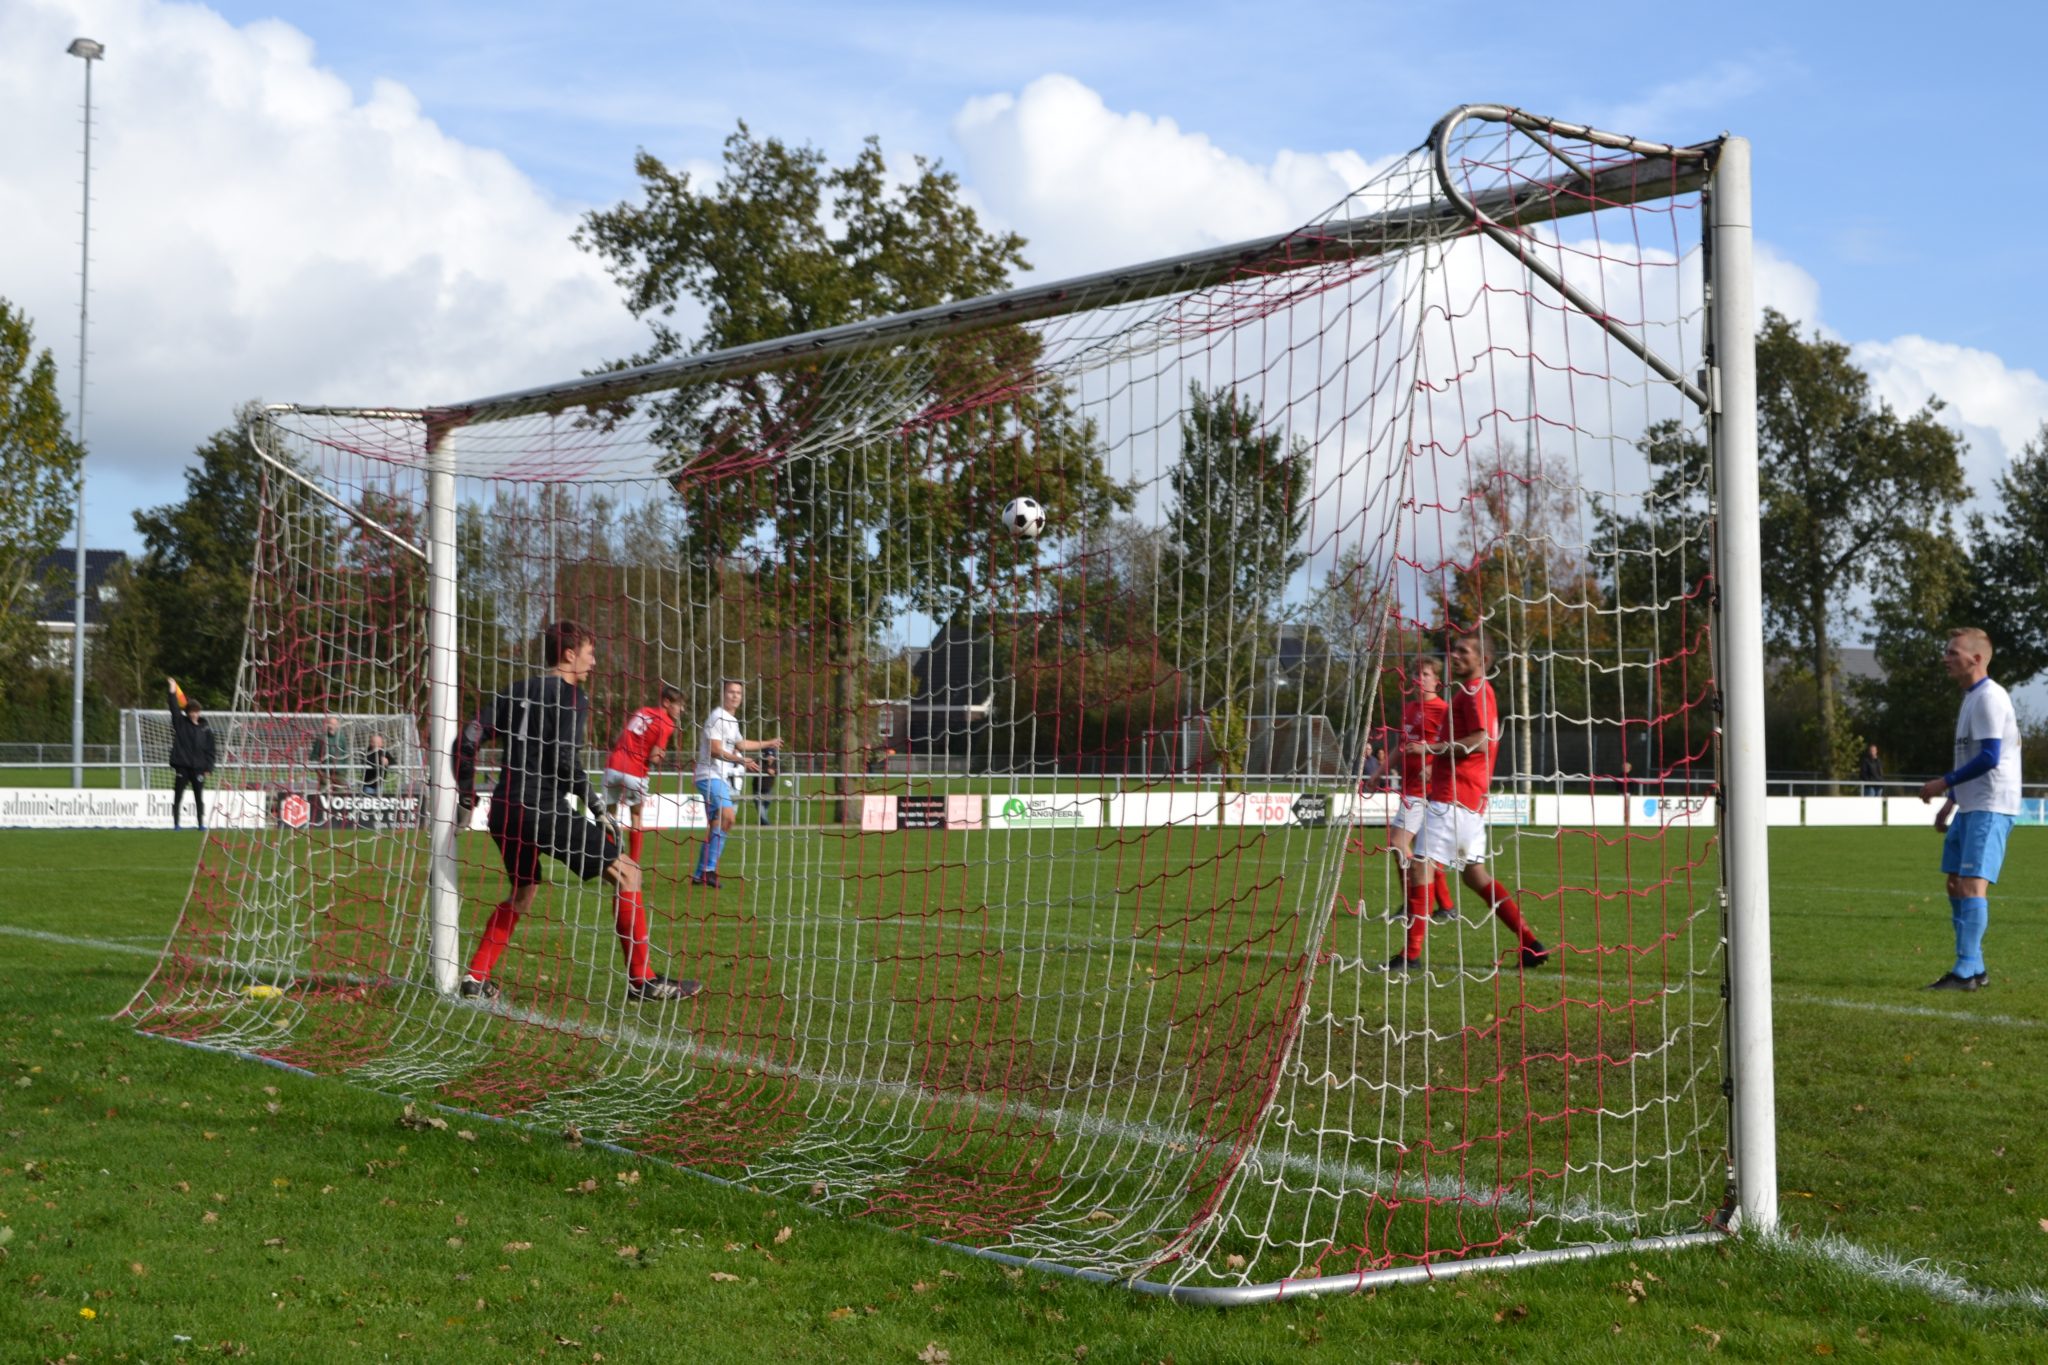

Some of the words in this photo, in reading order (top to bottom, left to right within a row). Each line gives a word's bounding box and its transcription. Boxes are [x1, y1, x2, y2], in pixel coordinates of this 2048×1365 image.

[3, 792, 138, 816] administratiekantoor
[1026, 800, 1046, 808] VISIT
[1250, 796, 1272, 804] CLUB
[1275, 796, 1292, 804] VAN
[1492, 797, 1527, 809] Holland
[1658, 799, 1671, 809] DE
[1674, 799, 1703, 810] JONG
[1256, 807, 1284, 821] 100
